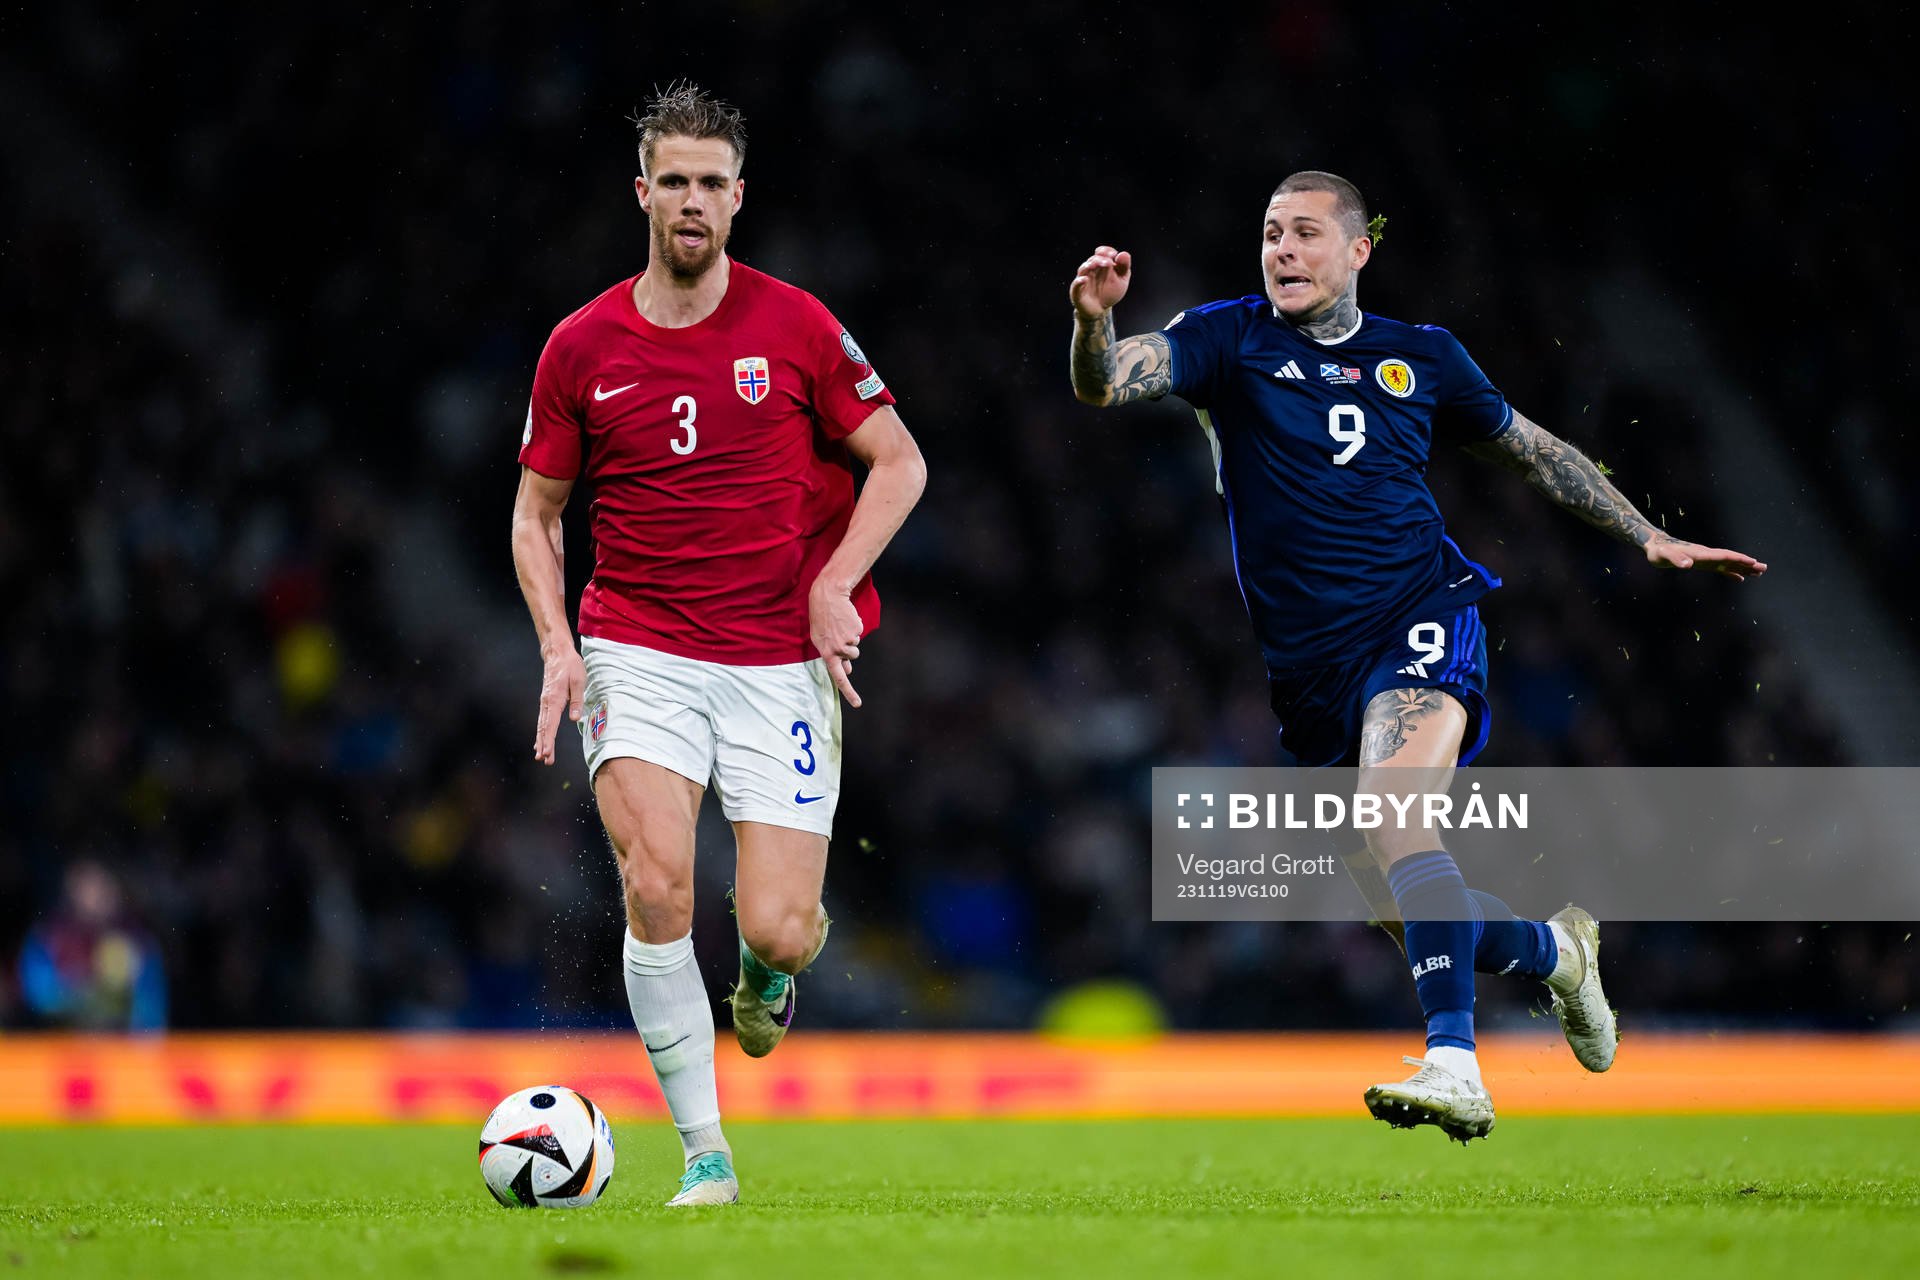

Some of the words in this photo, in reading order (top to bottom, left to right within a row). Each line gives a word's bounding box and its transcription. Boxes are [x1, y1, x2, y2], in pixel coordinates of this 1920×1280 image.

[669, 395, 697, 455] 3
[1328, 404, 1366, 465] 9
[1408, 622, 1445, 664] 9
[791, 720, 816, 776] 3
[1412, 954, 1453, 981] ALBA
